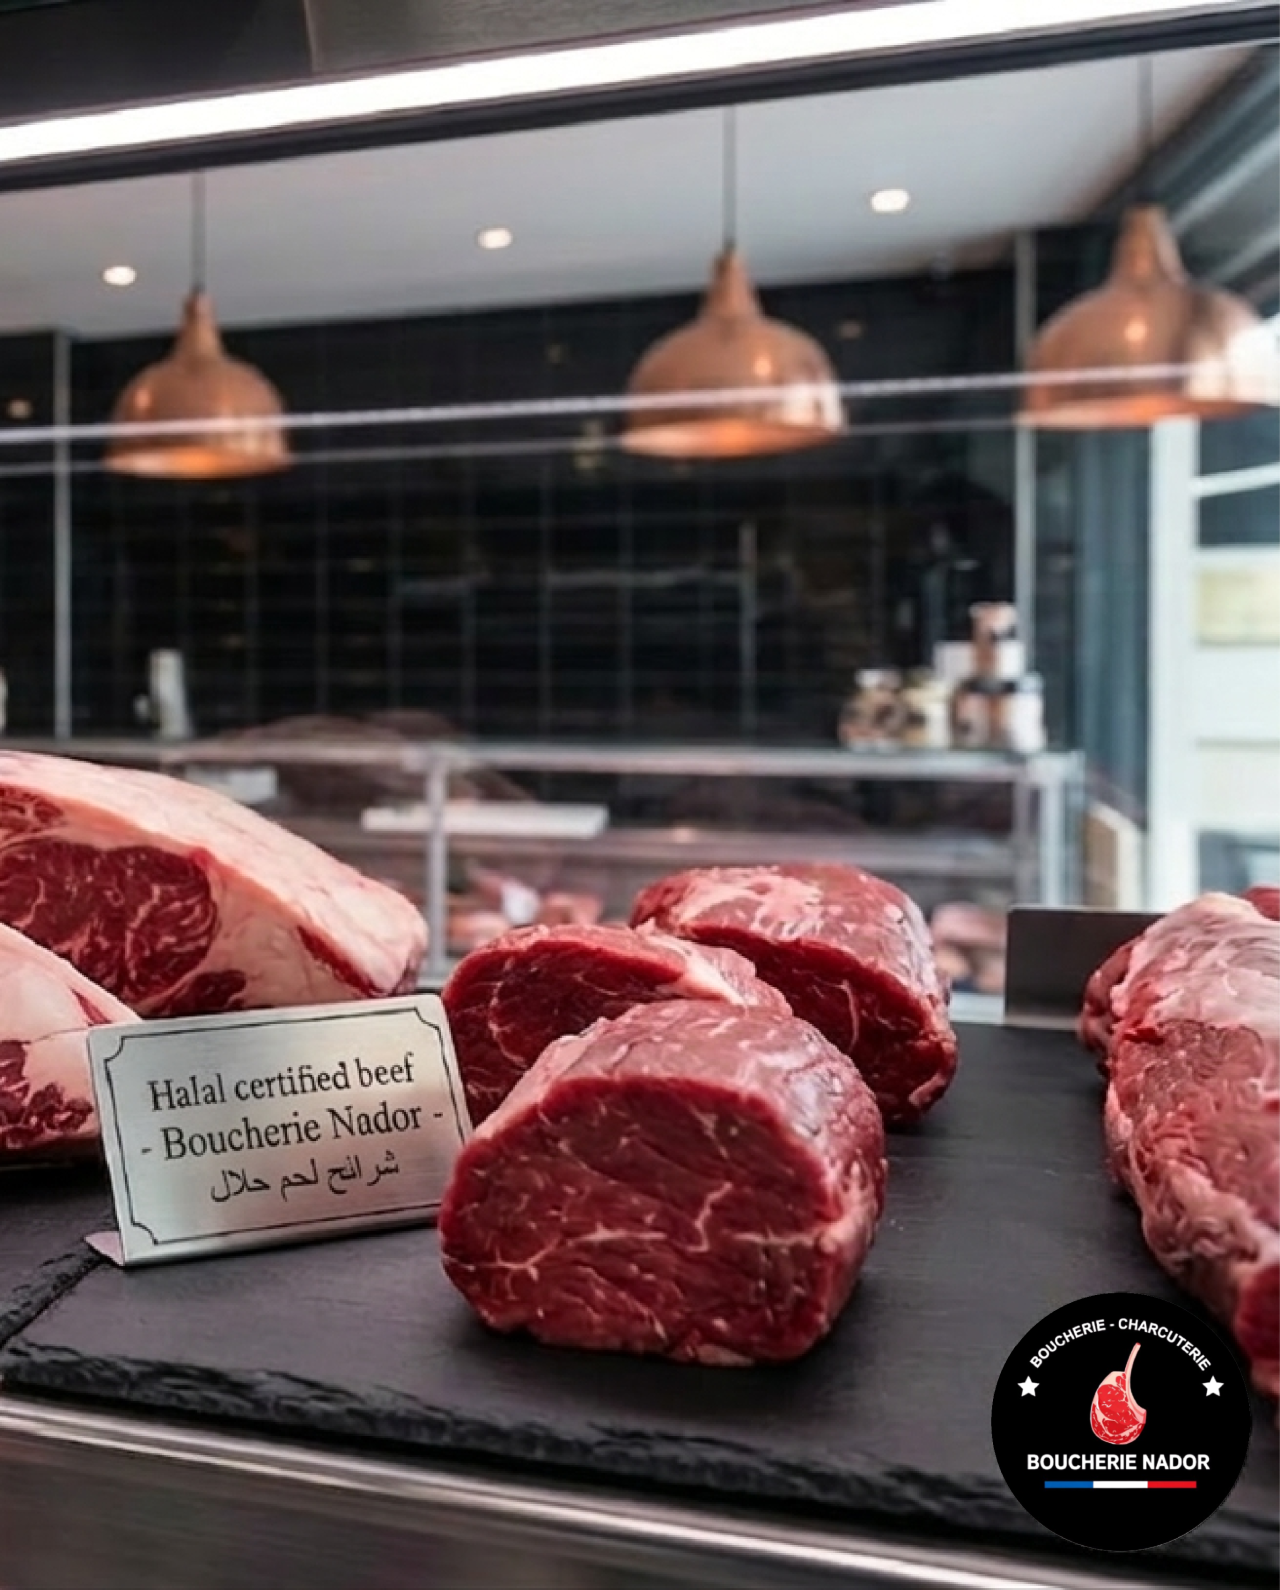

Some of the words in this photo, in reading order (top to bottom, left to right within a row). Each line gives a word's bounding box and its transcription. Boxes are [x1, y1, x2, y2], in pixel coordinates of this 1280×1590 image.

[147, 1073, 226, 1111] Halal
[233, 1061, 350, 1101] certified
[355, 1052, 415, 1088] beef
[160, 1111, 322, 1160] Boucherie
[326, 1100, 422, 1140] Nador
[210, 1168, 270, 1203] حلال
[280, 1158, 319, 1202] لحم
